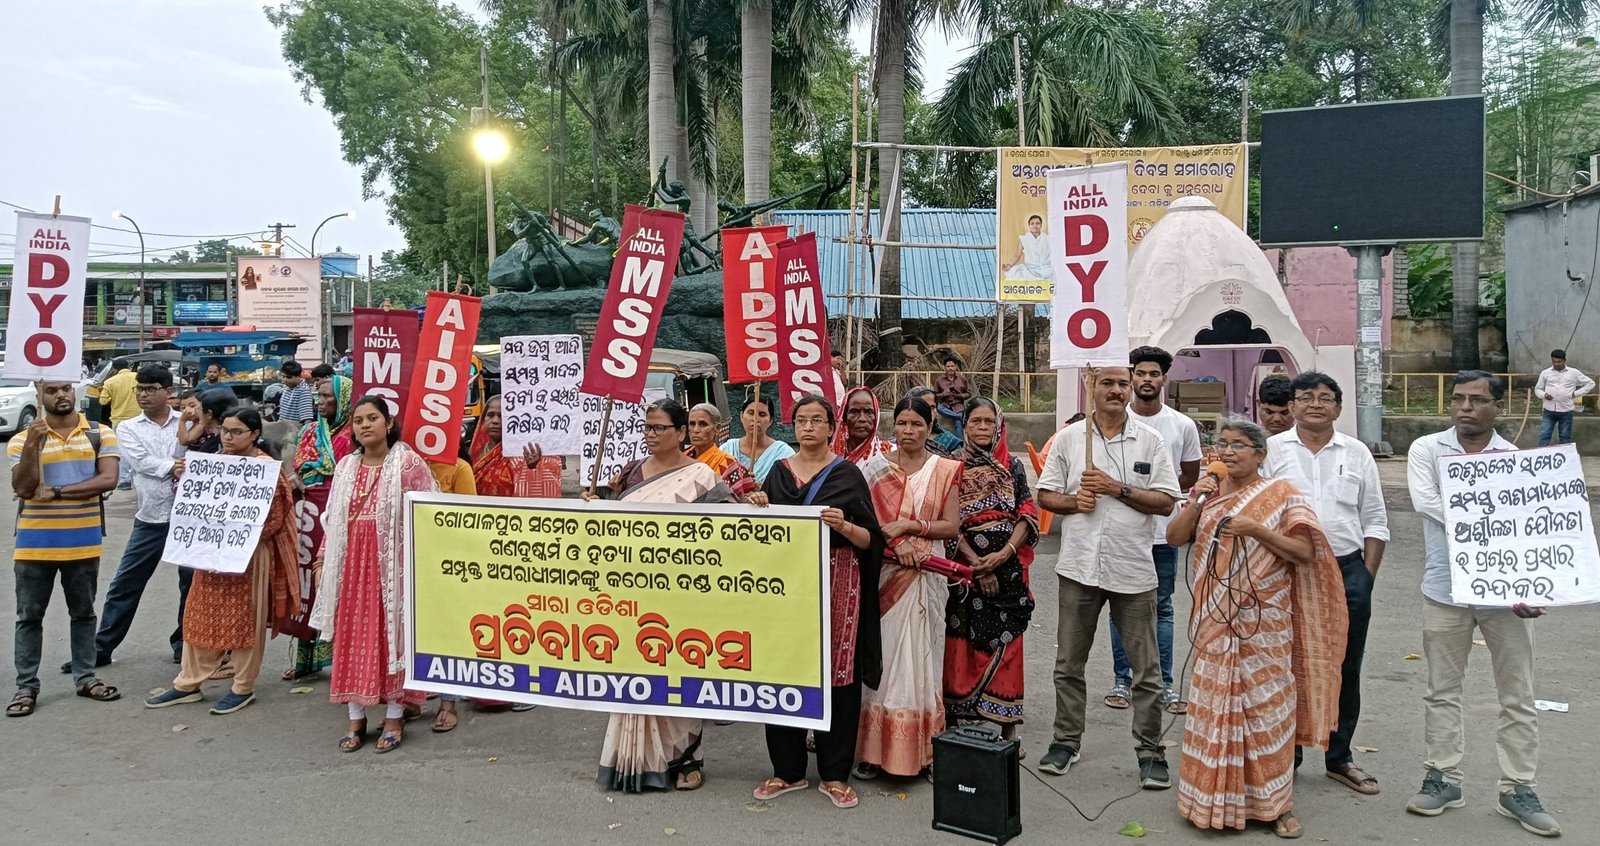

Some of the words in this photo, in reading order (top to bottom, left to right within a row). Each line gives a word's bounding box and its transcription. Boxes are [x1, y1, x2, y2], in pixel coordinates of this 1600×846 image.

[1134, 159, 1168, 176] ଦିବସ
[1174, 162, 1236, 178] ସମାରୋହ
[1068, 184, 1103, 198] ALL
[1132, 184, 1159, 194] ଦେବା
[1176, 184, 1223, 196] ଅନୁରୋଧ
[1064, 197, 1108, 210] INDIA
[29, 240, 71, 250] INDIA
[34, 228, 66, 240] ALL
[636, 227, 664, 242] ALL
[629, 239, 665, 257] INDIA
[787, 258, 806, 270] ALL
[784, 273, 811, 285] INDIA
[1064, 214, 1111, 349] DYO
[24, 252, 70, 367] DYO
[740, 232, 779, 377] AIDSO
[602, 257, 665, 378] MSS
[364, 337, 400, 349] INDIA
[369, 326, 397, 337] ALL
[554, 336, 580, 354] ଆଦି
[784, 287, 824, 402] MSS
[415, 298, 465, 456] AIDSO
[505, 366, 539, 386] ସମସ୍ତ
[550, 414, 571, 434] କର
[1520, 452, 1566, 477] ସମେତ
[1450, 490, 1495, 515] ସମସ୍ତ
[434, 510, 523, 536] ଗୋପାଳପୁର
[528, 516, 579, 535] ସମେତ
[585, 519, 659, 539] ରାଜ୍ୟରେ
[666, 517, 714, 542] ସମ୍ପ୍ରତି
[720, 518, 791, 545] ଘଟିଥିବା
[1525, 506, 1583, 536] ଯୌନତା
[489, 538, 562, 562] ଗଣଦୁଷ୍କର୍ମ
[566, 544, 581, 560] ଓ
[587, 545, 632, 565] ହତ୍ୟା
[639, 547, 723, 567] ଘଟଣାରେ
[1524, 544, 1574, 572] ପ୍ରସାର
[441, 559, 482, 582] ସମ୍ପୃକ୍ତ
[487, 563, 601, 592] ଅପରାଧୀମାନଙ୍କୁ
[606, 571, 671, 591] କଠୋର
[677, 573, 711, 593] ଦଣ୍ଡ
[717, 570, 786, 596] ଦାବିରେ
[527, 593, 569, 614] ସାରା
[577, 593, 638, 617] ଓଡିଶା
[470, 603, 619, 663] ପ୍ରତିବାଦ
[636, 612, 752, 671] ଦିବସ
[427, 657, 515, 687] AIMSS
[555, 671, 652, 700] AIDYO
[696, 681, 803, 712] AIDSO
